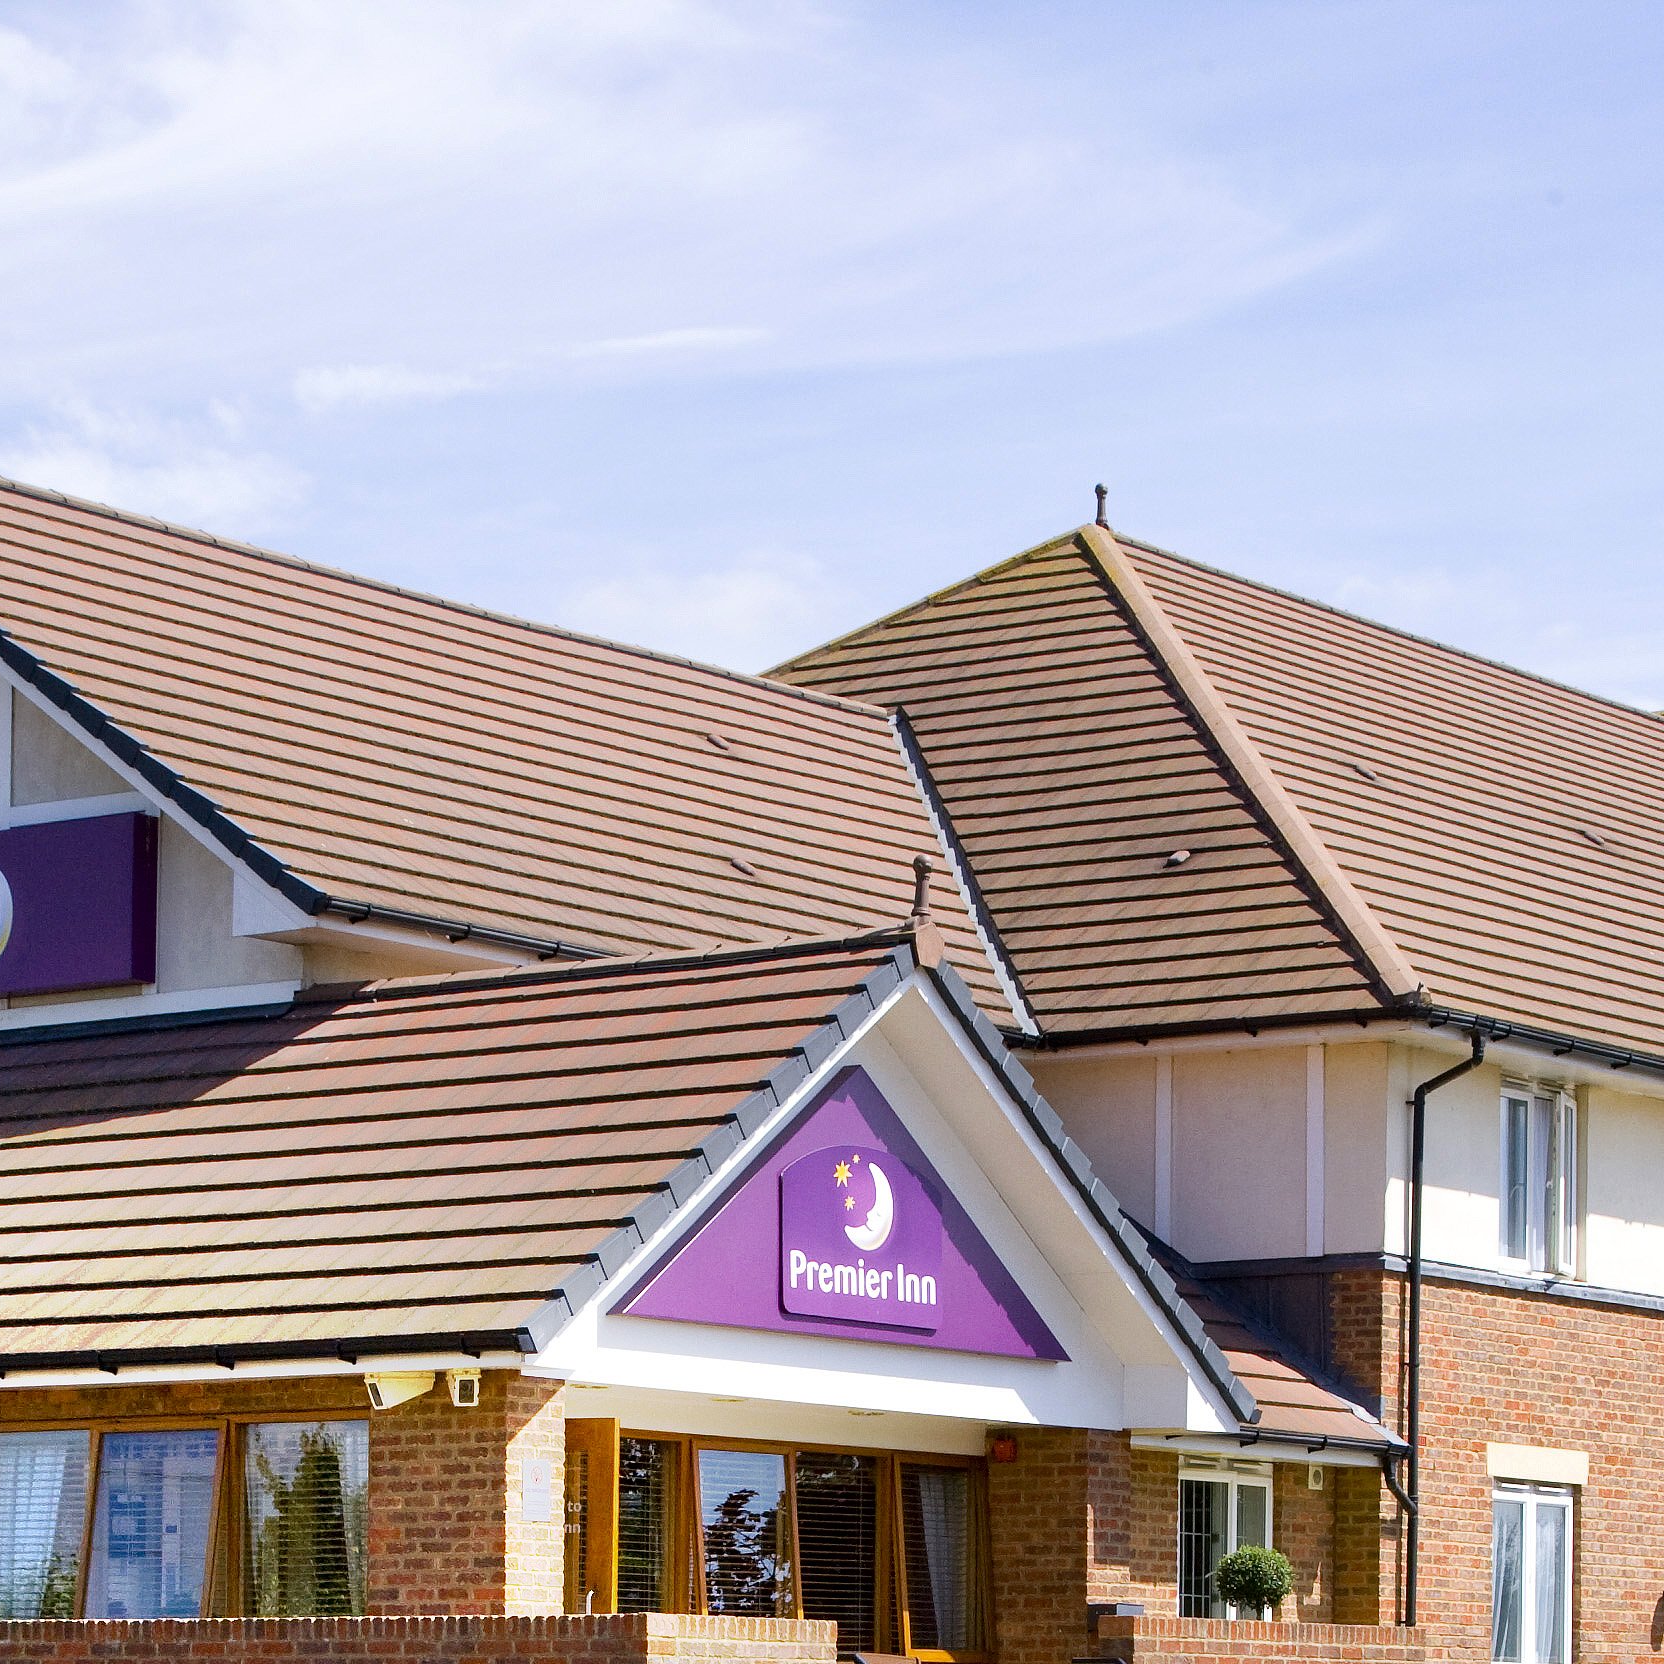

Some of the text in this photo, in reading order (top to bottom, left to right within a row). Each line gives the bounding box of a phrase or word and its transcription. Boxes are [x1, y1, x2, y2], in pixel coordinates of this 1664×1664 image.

[790, 1249, 937, 1306] Premier Inn
[567, 1500, 582, 1513] to
[564, 1523, 581, 1534] nn
